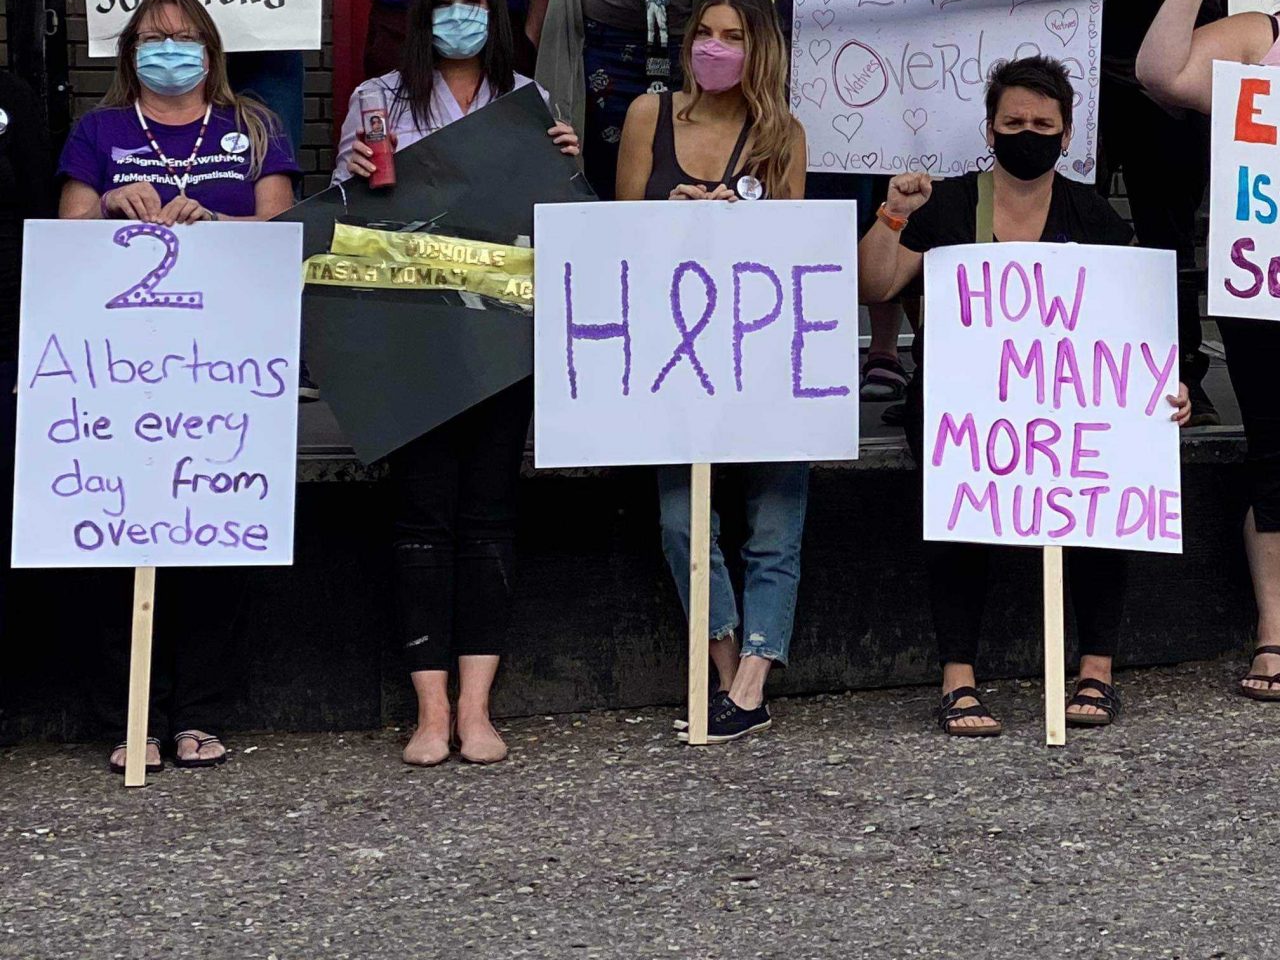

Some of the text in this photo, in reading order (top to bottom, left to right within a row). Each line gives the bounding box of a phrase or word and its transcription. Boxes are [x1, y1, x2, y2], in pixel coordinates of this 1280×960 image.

[105, 223, 204, 309] 2
[957, 261, 1086, 331] HOW
[565, 259, 850, 400] HOPE
[29, 333, 289, 398] Albertans
[999, 337, 1178, 416] MANY
[48, 397, 249, 464] die every
[932, 412, 1111, 479] MORE
[51, 456, 269, 517] day from
[947, 481, 1181, 540] MUST DIE
[73, 506, 269, 551] overdose
